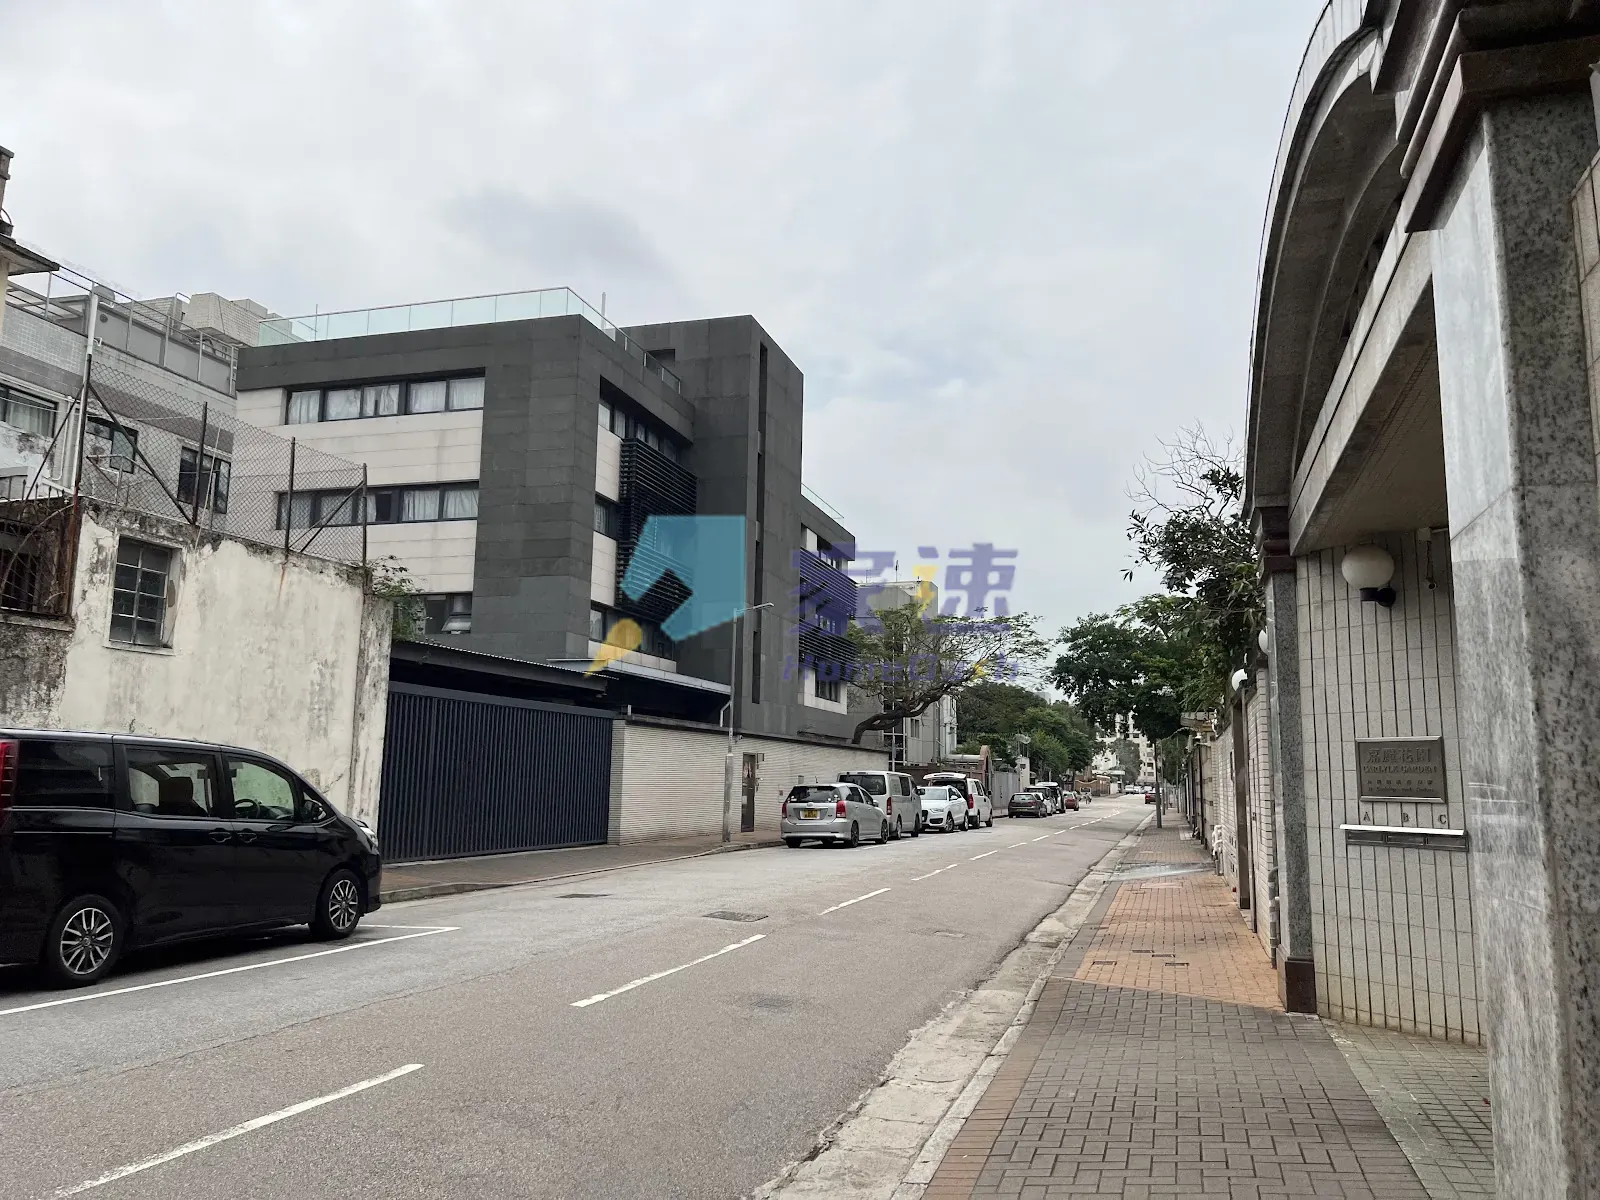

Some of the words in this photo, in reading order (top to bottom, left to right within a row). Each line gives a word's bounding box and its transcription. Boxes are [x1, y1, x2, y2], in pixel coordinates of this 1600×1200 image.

[1363, 811, 1371, 822] A
[1402, 813, 1410, 822] B
[1438, 814, 1447, 824] C
